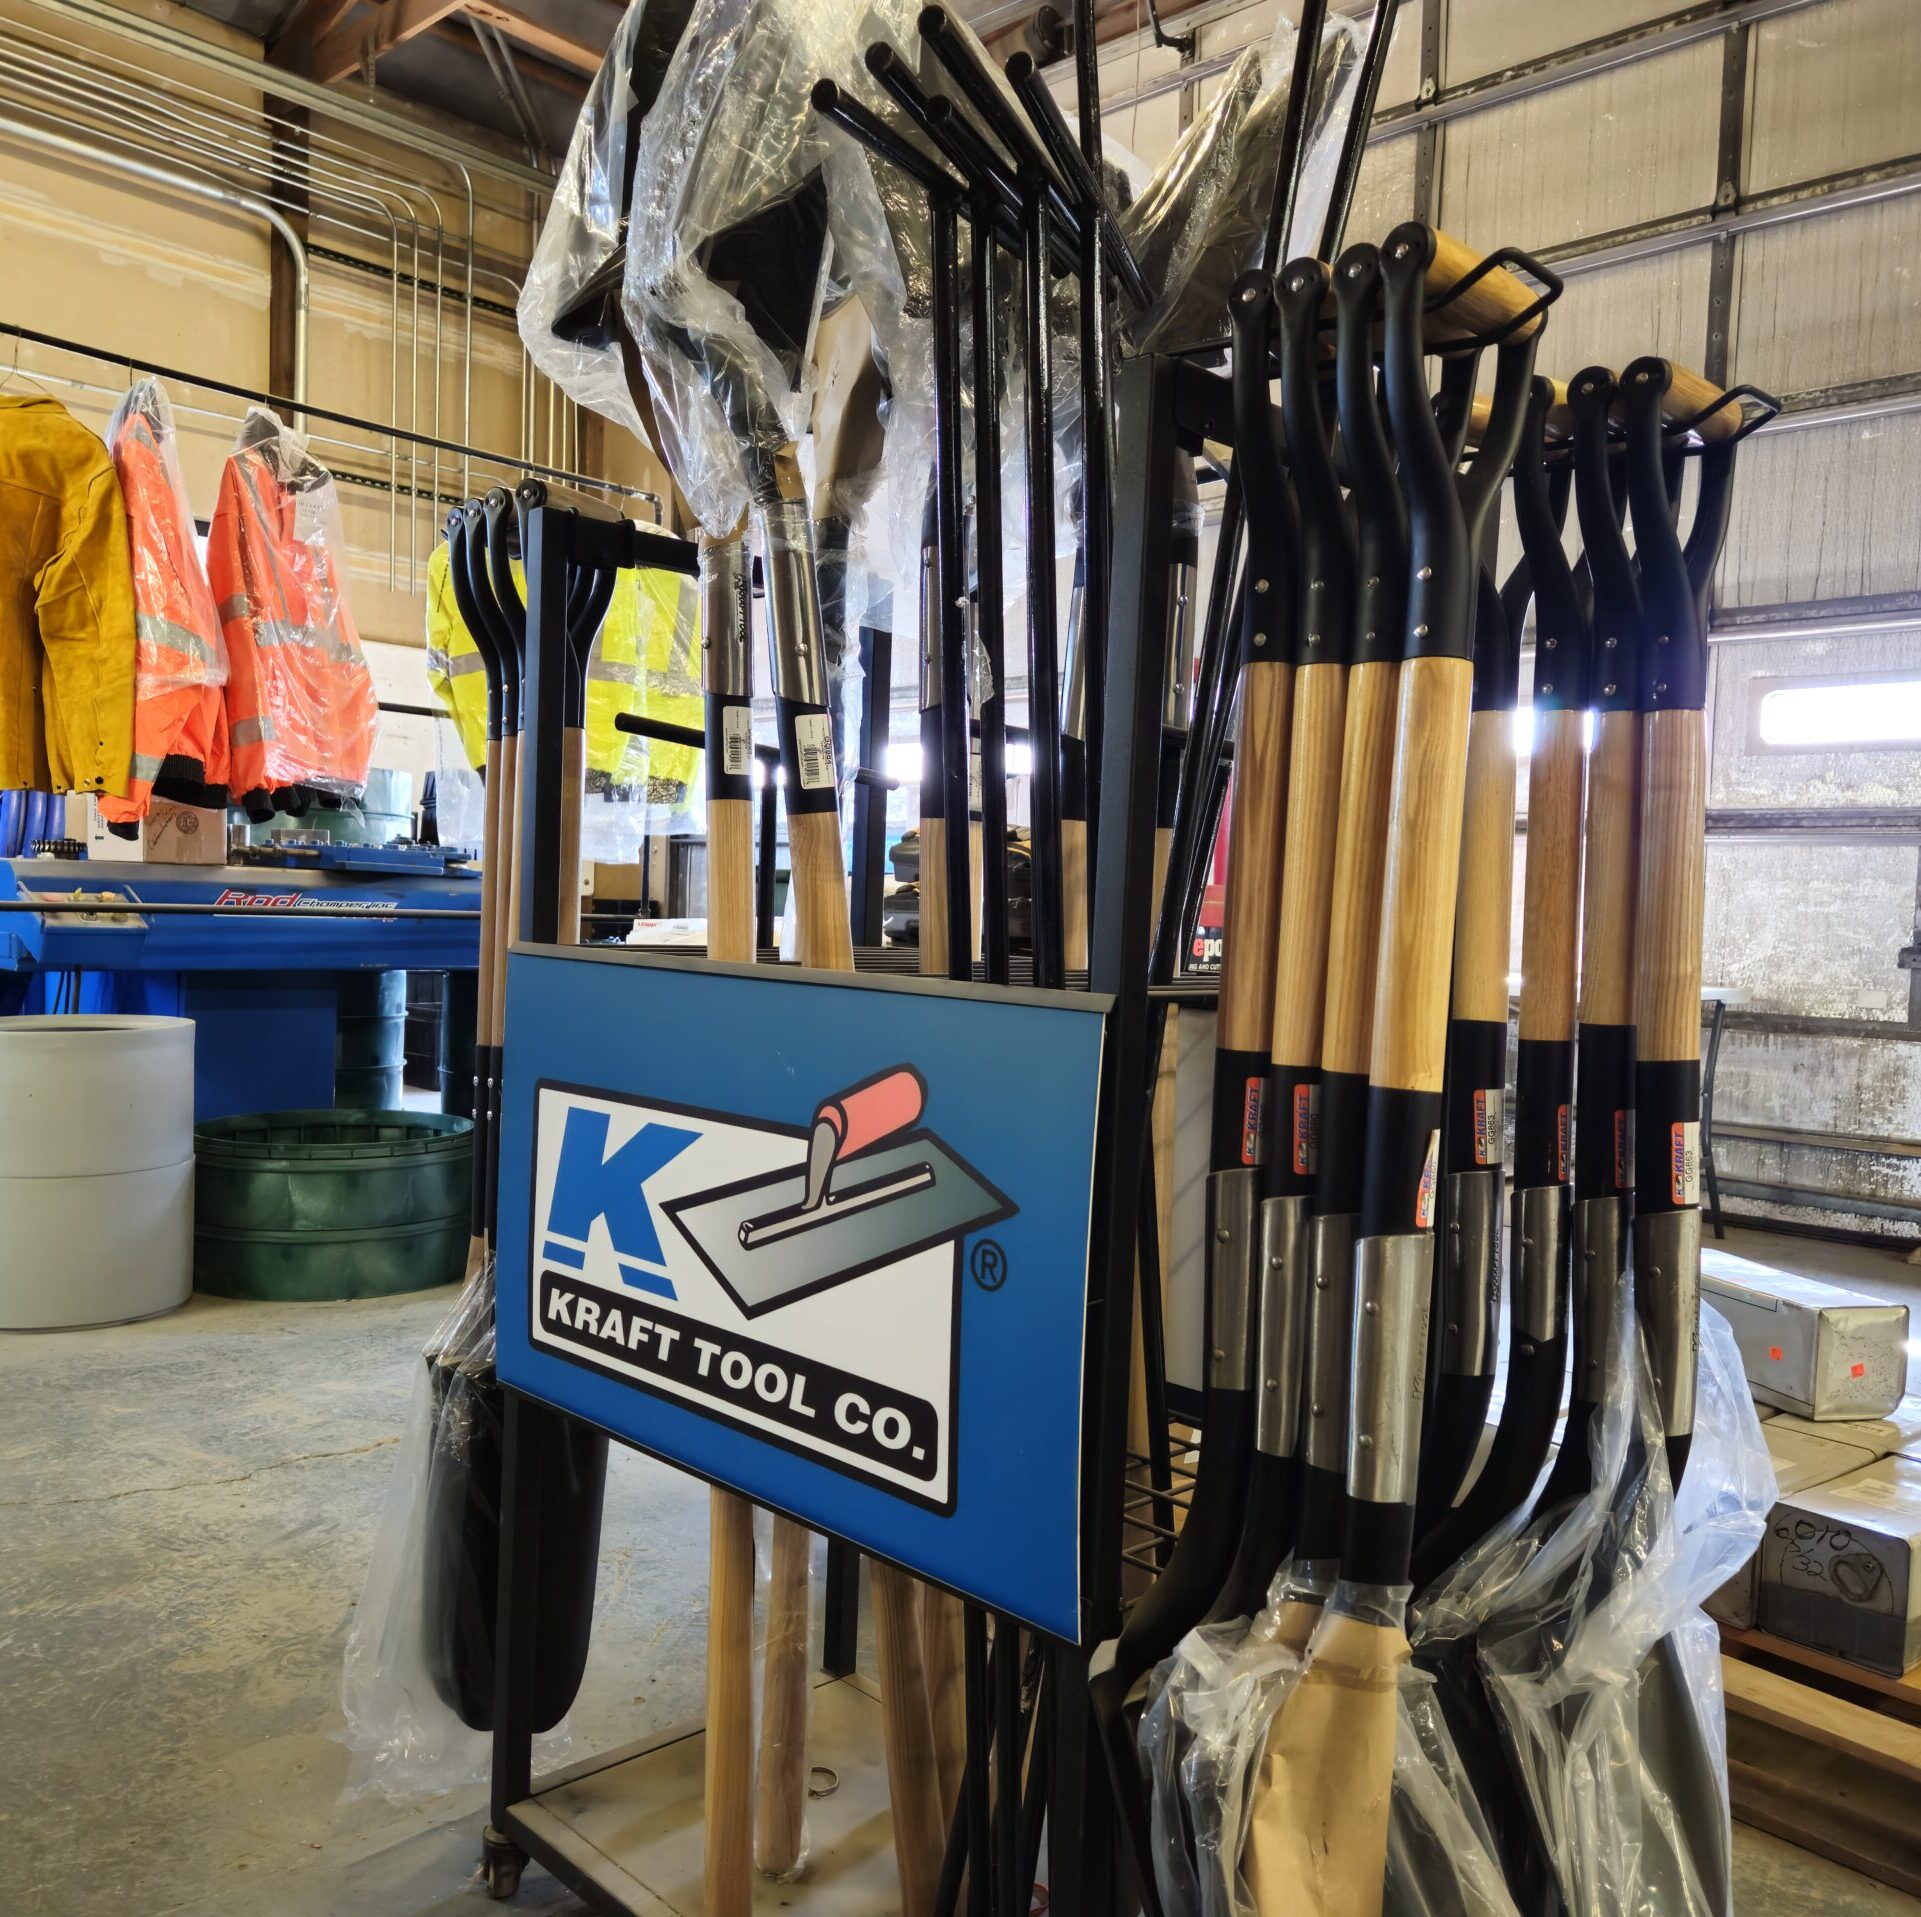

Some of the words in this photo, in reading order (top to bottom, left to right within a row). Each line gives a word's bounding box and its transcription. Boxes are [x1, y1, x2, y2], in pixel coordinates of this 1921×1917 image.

[215, 889, 301, 908] Rod
[1247, 1087, 1259, 1131] KRAFT
[1298, 1095, 1309, 1140] KRAFT
[1476, 1100, 1485, 1135] KRAFT
[1673, 1132, 1684, 1173] KRAFT
[1685, 1150, 1693, 1183] GG863
[547, 1287, 680, 1361] KRAFT
[694, 1338, 816, 1417] TOOL
[834, 1392, 926, 1462] CO.
